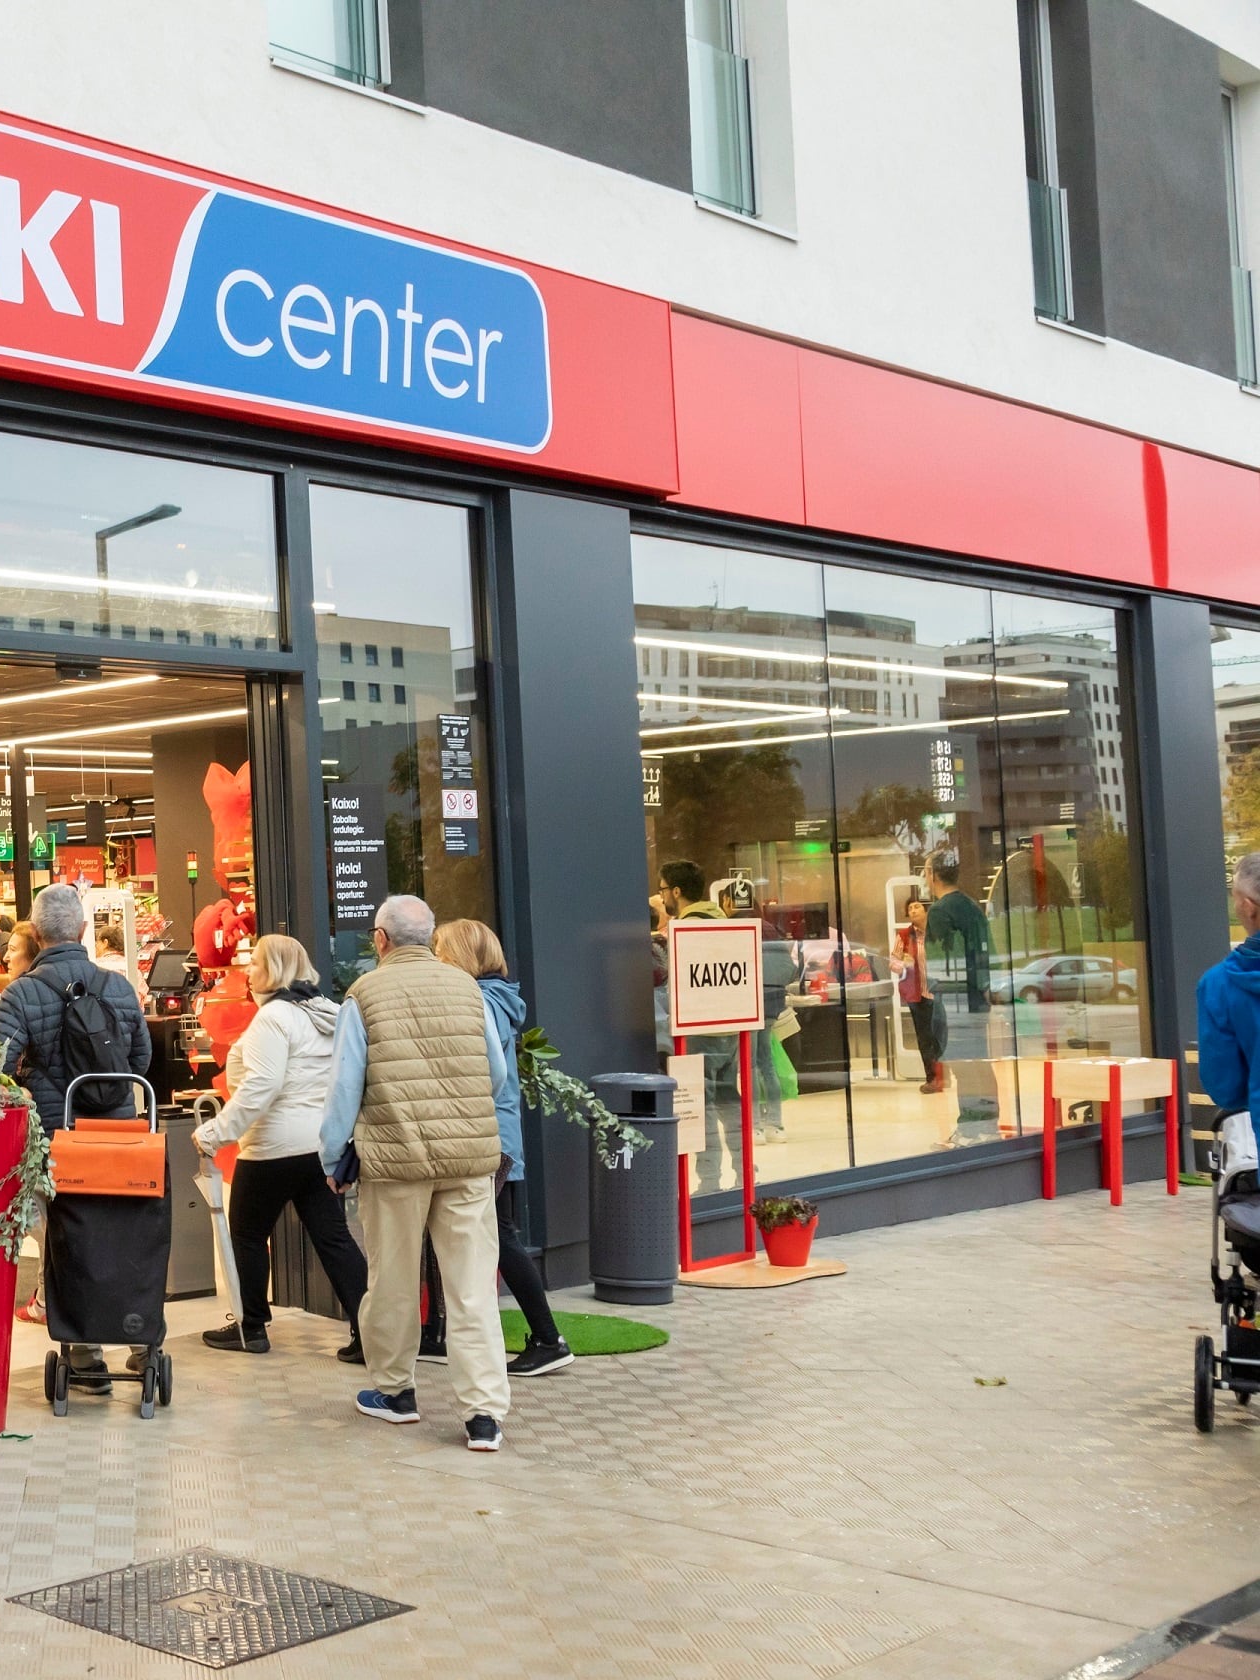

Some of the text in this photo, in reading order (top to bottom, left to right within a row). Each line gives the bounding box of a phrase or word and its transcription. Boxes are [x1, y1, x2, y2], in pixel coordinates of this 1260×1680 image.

[215, 268, 504, 404] center
[331, 797, 360, 810] Kaixo!
[335, 862, 362, 877] ¡Hola!
[336, 880, 368, 889] Horario de
[336, 891, 365, 901] apertura:
[689, 961, 747, 989] KAIXO!
